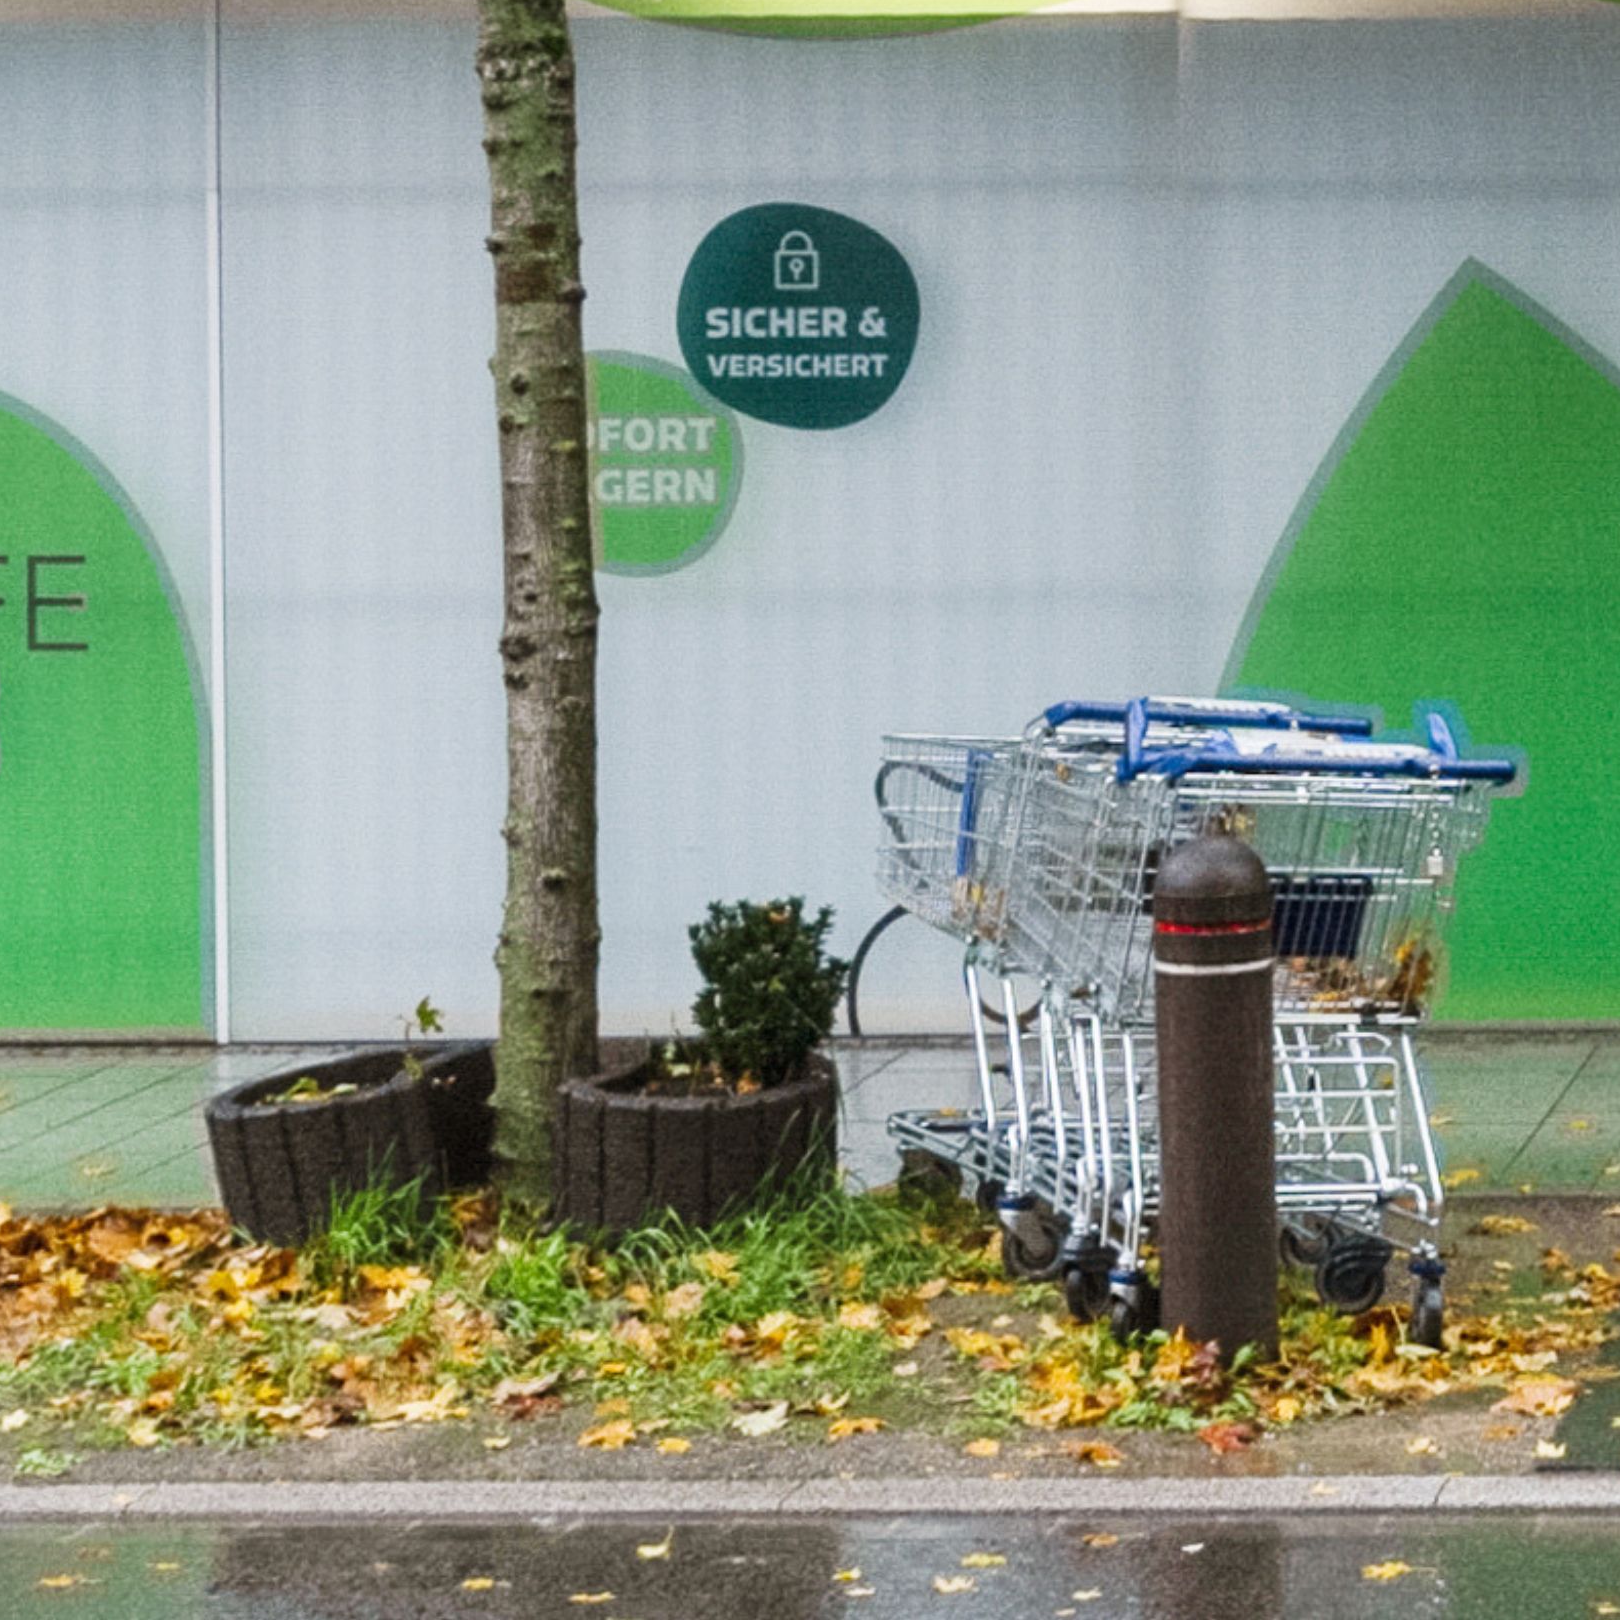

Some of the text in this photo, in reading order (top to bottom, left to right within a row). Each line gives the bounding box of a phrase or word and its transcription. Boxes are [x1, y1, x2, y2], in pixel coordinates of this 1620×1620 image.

[706, 307, 887, 338] SICHER &
[708, 353, 887, 379] VERSICHERT
[587, 417, 717, 452] FORT
[593, 468, 717, 503] GERN
